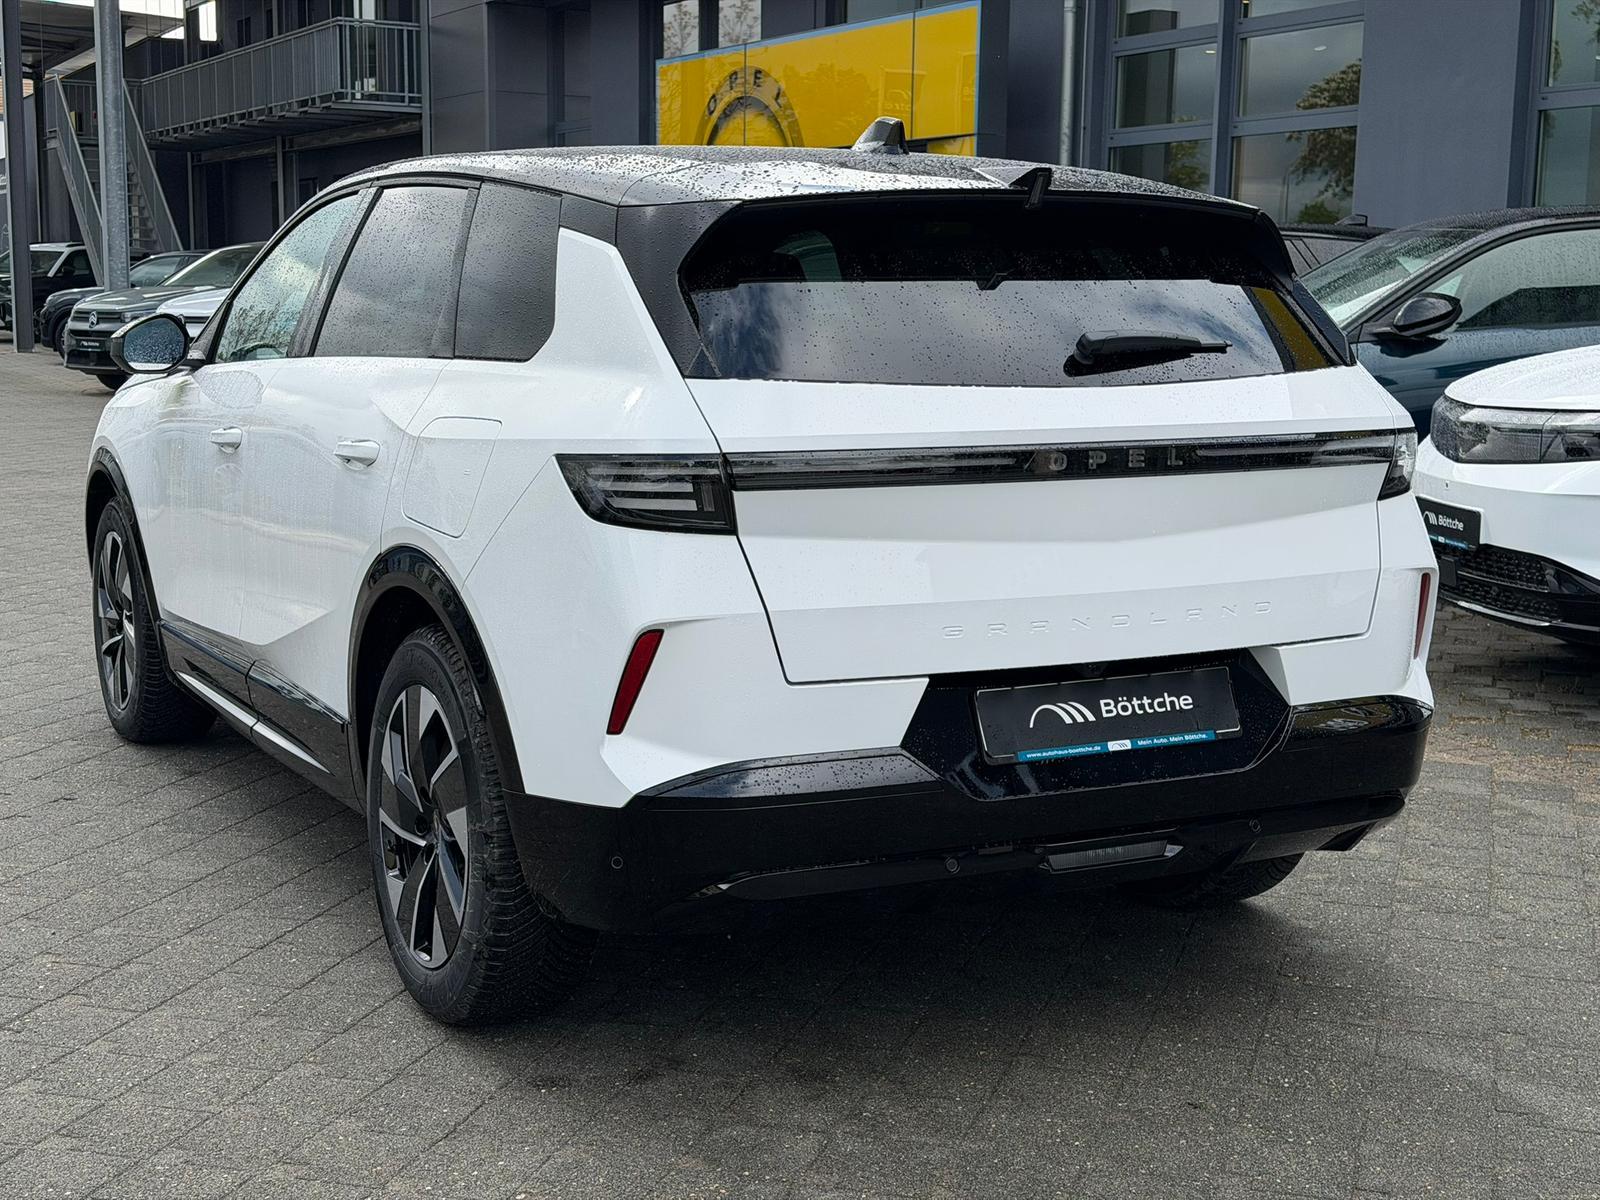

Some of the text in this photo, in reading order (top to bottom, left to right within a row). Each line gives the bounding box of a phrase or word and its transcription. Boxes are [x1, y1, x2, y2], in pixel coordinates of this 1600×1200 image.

[707, 69, 783, 116] OPEL
[1049, 447, 1184, 472] OPEL
[1438, 514, 1464, 531] Böttche
[942, 600, 1272, 639] GRANDLAND
[1099, 692, 1194, 719] Böttche
[1026, 745, 1101, 758] www.autohaus-boettche.de
